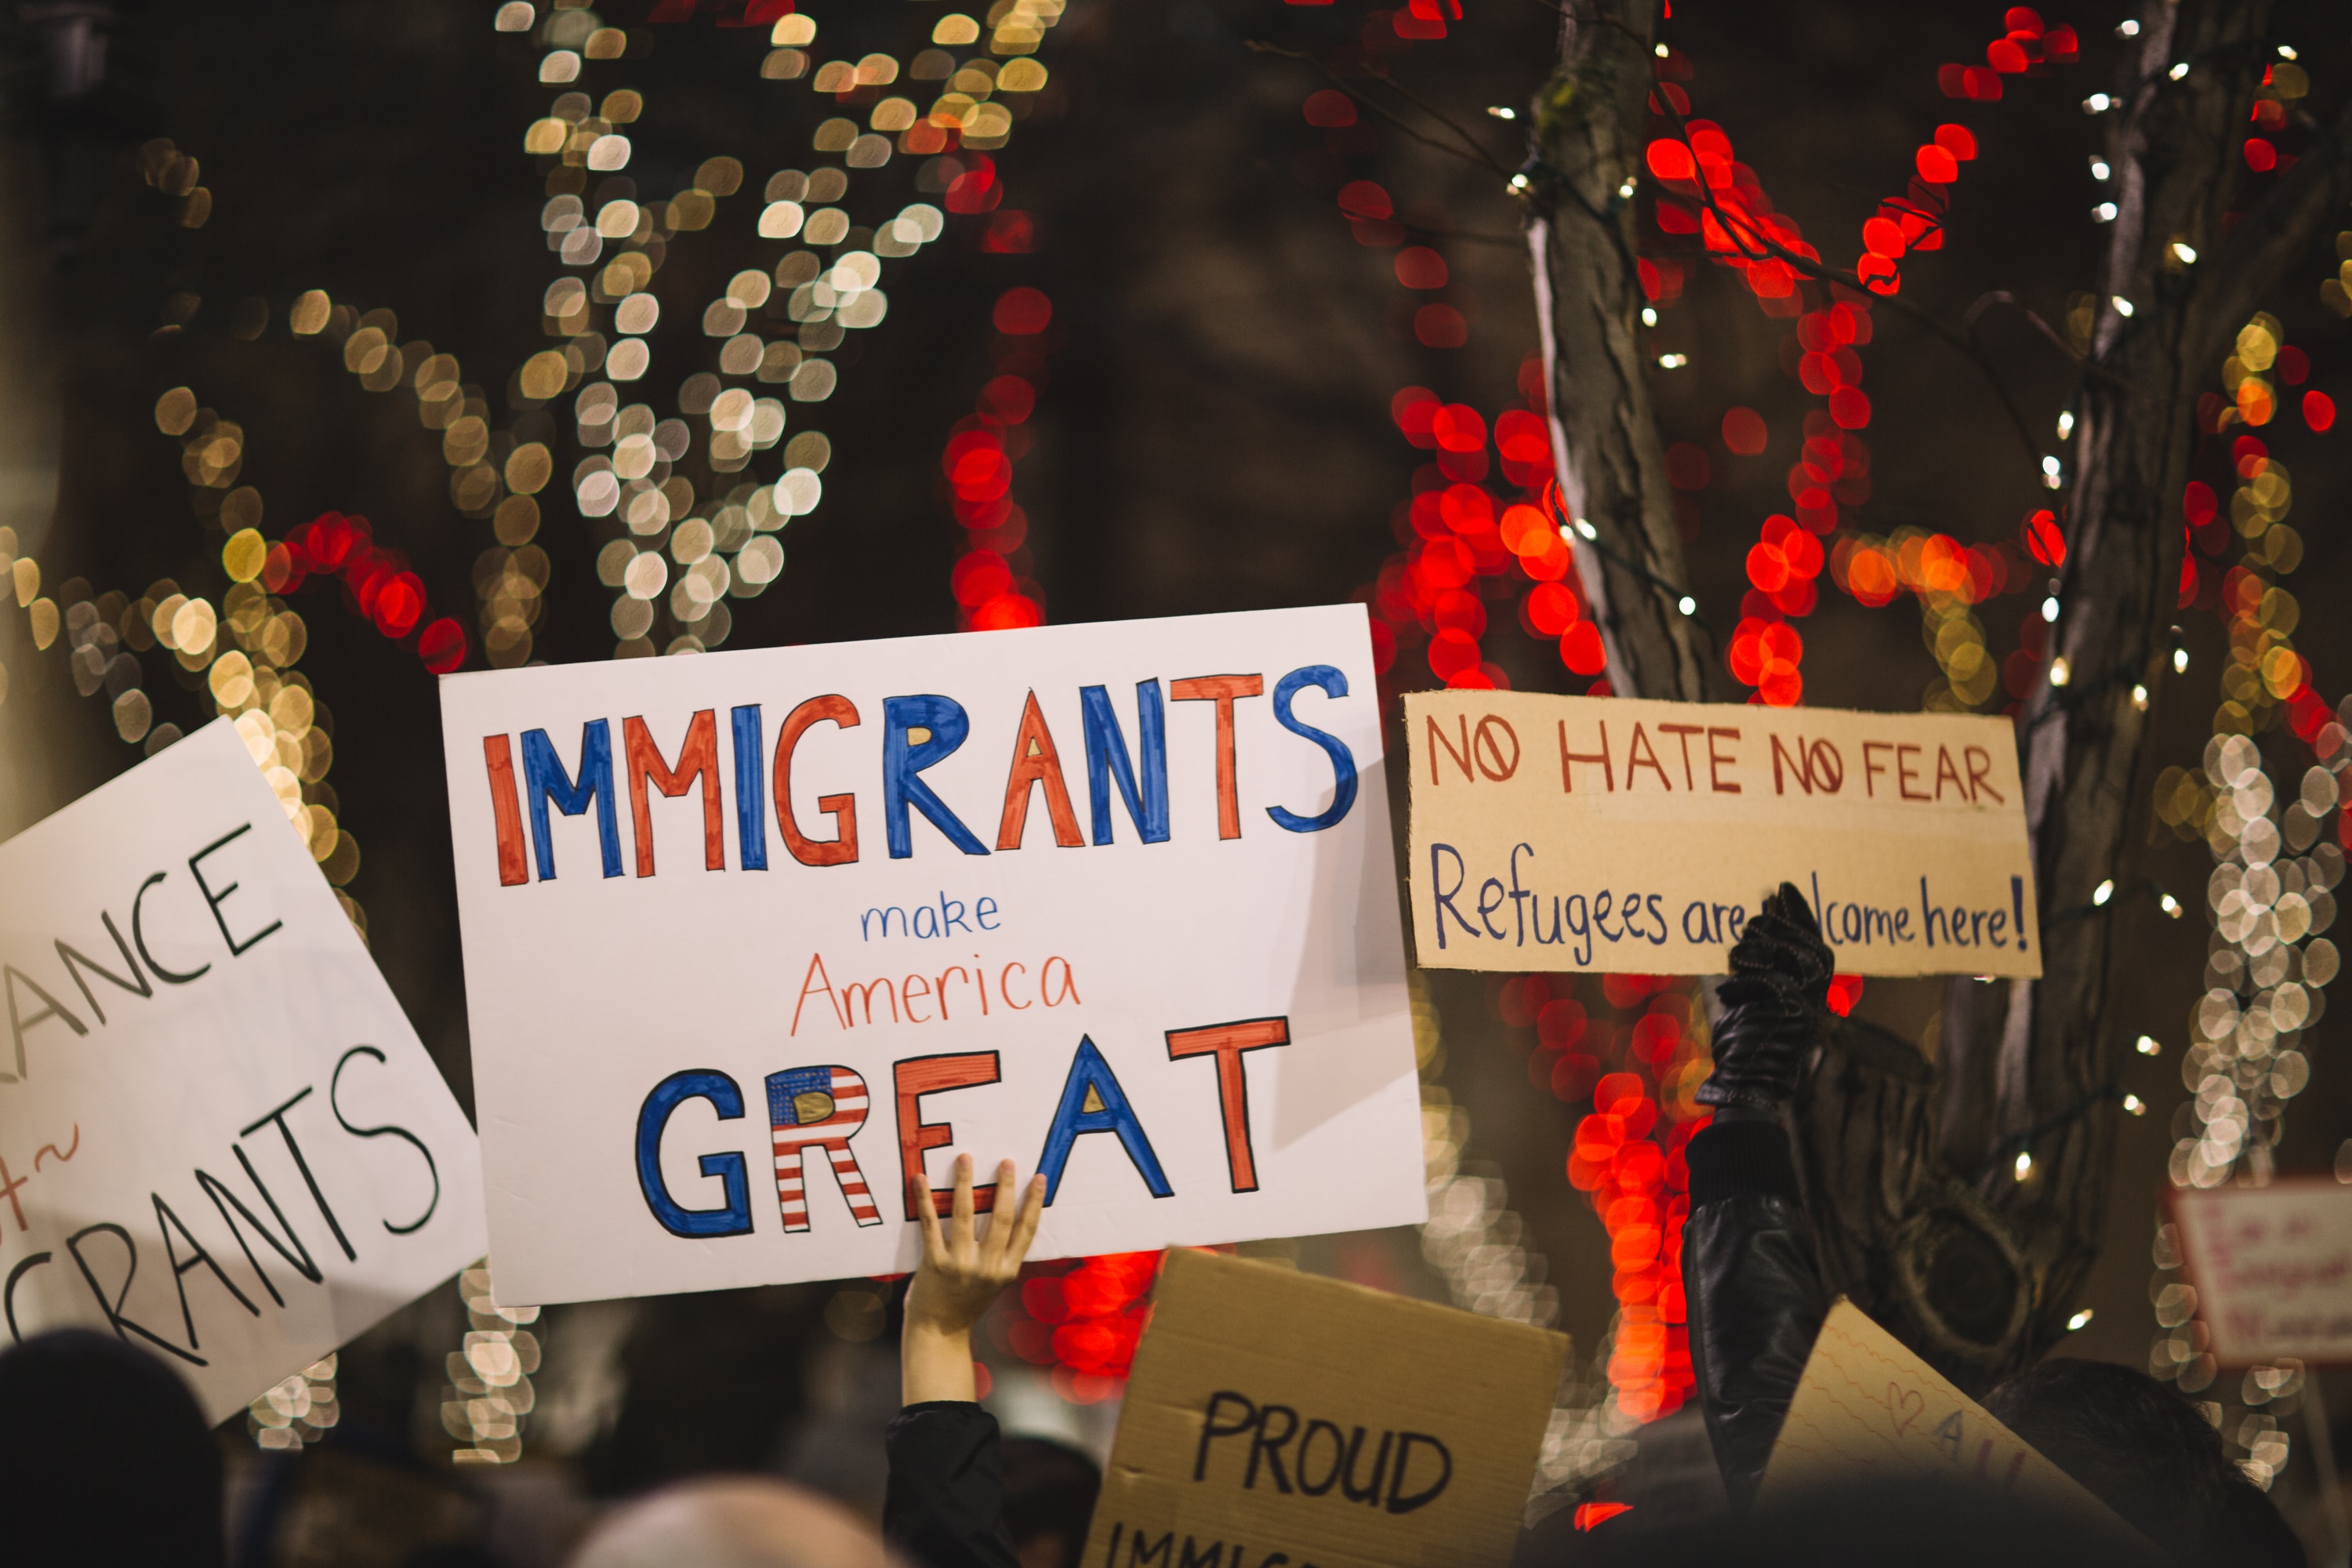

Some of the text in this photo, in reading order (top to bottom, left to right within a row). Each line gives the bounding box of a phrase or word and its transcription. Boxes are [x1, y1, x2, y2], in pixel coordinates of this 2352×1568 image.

[484, 665, 1358, 886] IMMIGRANTS
[1426, 713, 2005, 806] NO HATE NO FEAR
[861, 891, 1002, 942] make
[1431, 843, 2028, 966] Refugees are lcome here!
[791, 953, 1081, 1036] America
[635, 1016, 1290, 1239] GREAT
[1193, 1390, 1452, 1514] PROUD
